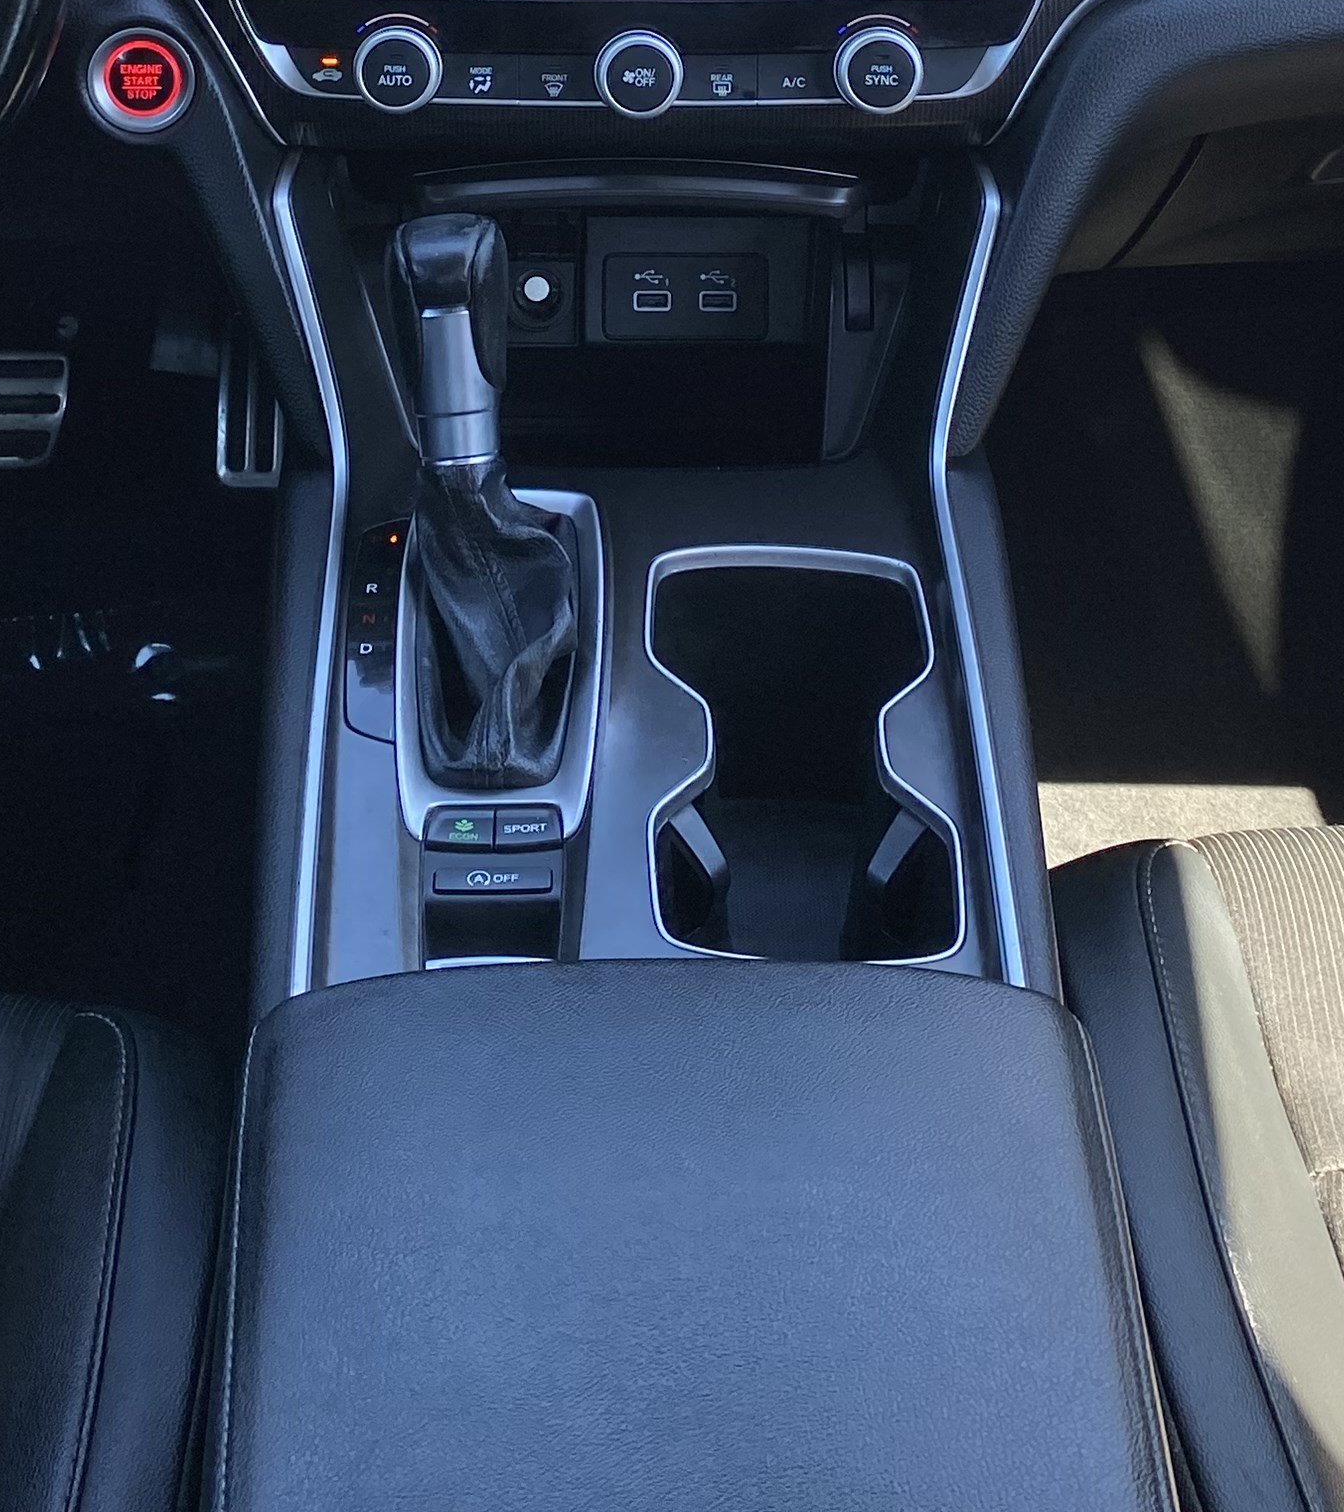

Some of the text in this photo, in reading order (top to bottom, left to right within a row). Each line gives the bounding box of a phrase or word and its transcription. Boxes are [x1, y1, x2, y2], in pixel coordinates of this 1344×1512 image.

[120, 64, 163, 74] ENGINE
[383, 64, 407, 74] PUSH
[469, 67, 493, 75] MODE
[635, 67, 656, 78] ON/
[870, 65, 893, 73] PUSH
[123, 76, 159, 86] START
[378, 74, 413, 87] AUTO
[541, 74, 569, 82] FRONT
[634, 77, 656, 88] OFF
[710, 74, 733, 82] REAR
[782, 76, 807, 88] A/C
[864, 74, 900, 87] SYNC
[127, 90, 157, 100] STOP
[366, 583, 378, 594] R
[362, 614, 376, 624] N
[359, 643, 373, 654] D
[503, 822, 548, 834] SPORT
[448, 832, 479, 841] ECON
[492, 874, 520, 883] OFF
